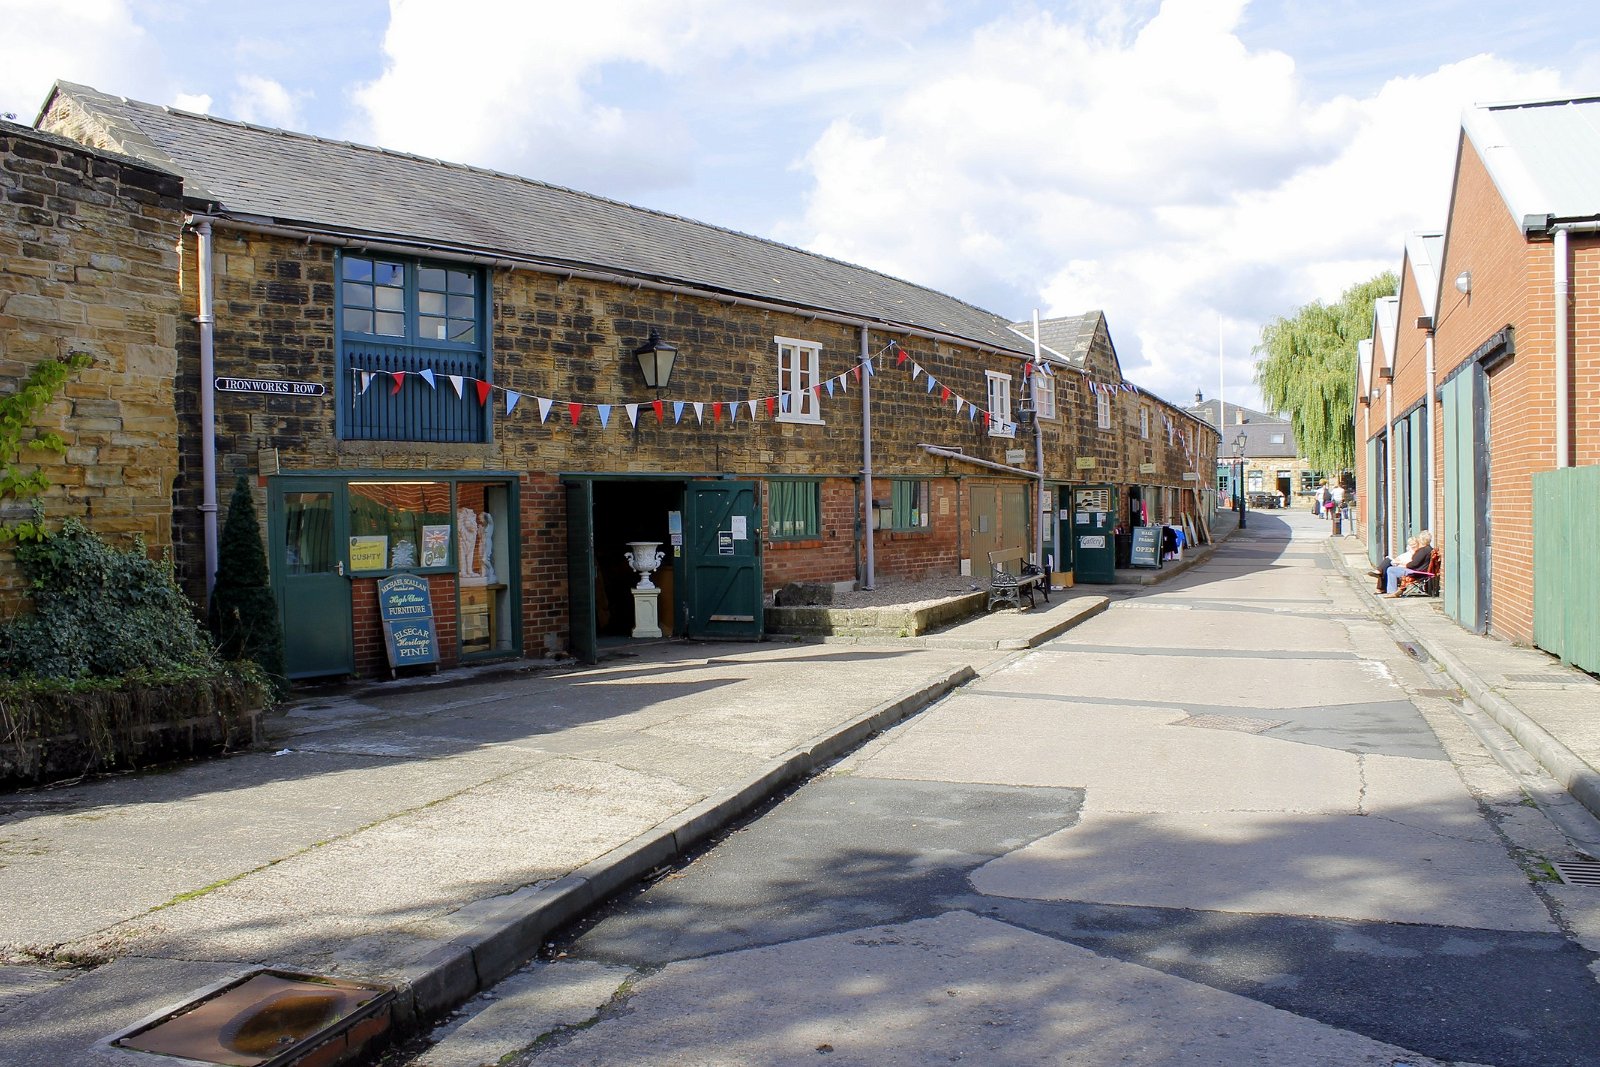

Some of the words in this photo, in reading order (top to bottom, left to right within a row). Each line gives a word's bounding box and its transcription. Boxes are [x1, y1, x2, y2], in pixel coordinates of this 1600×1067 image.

[225, 379, 289, 392] IRONWORKS
[293, 384, 316, 394] ROW
[351, 552, 381, 561] CUSHTY
[389, 595, 406, 606] High
[407, 594, 424, 602] Class
[388, 605, 426, 615] FURNITURE
[394, 628, 430, 640] ELSECAR
[397, 638, 430, 648] Heritage
[400, 648, 429, 657] PINE
